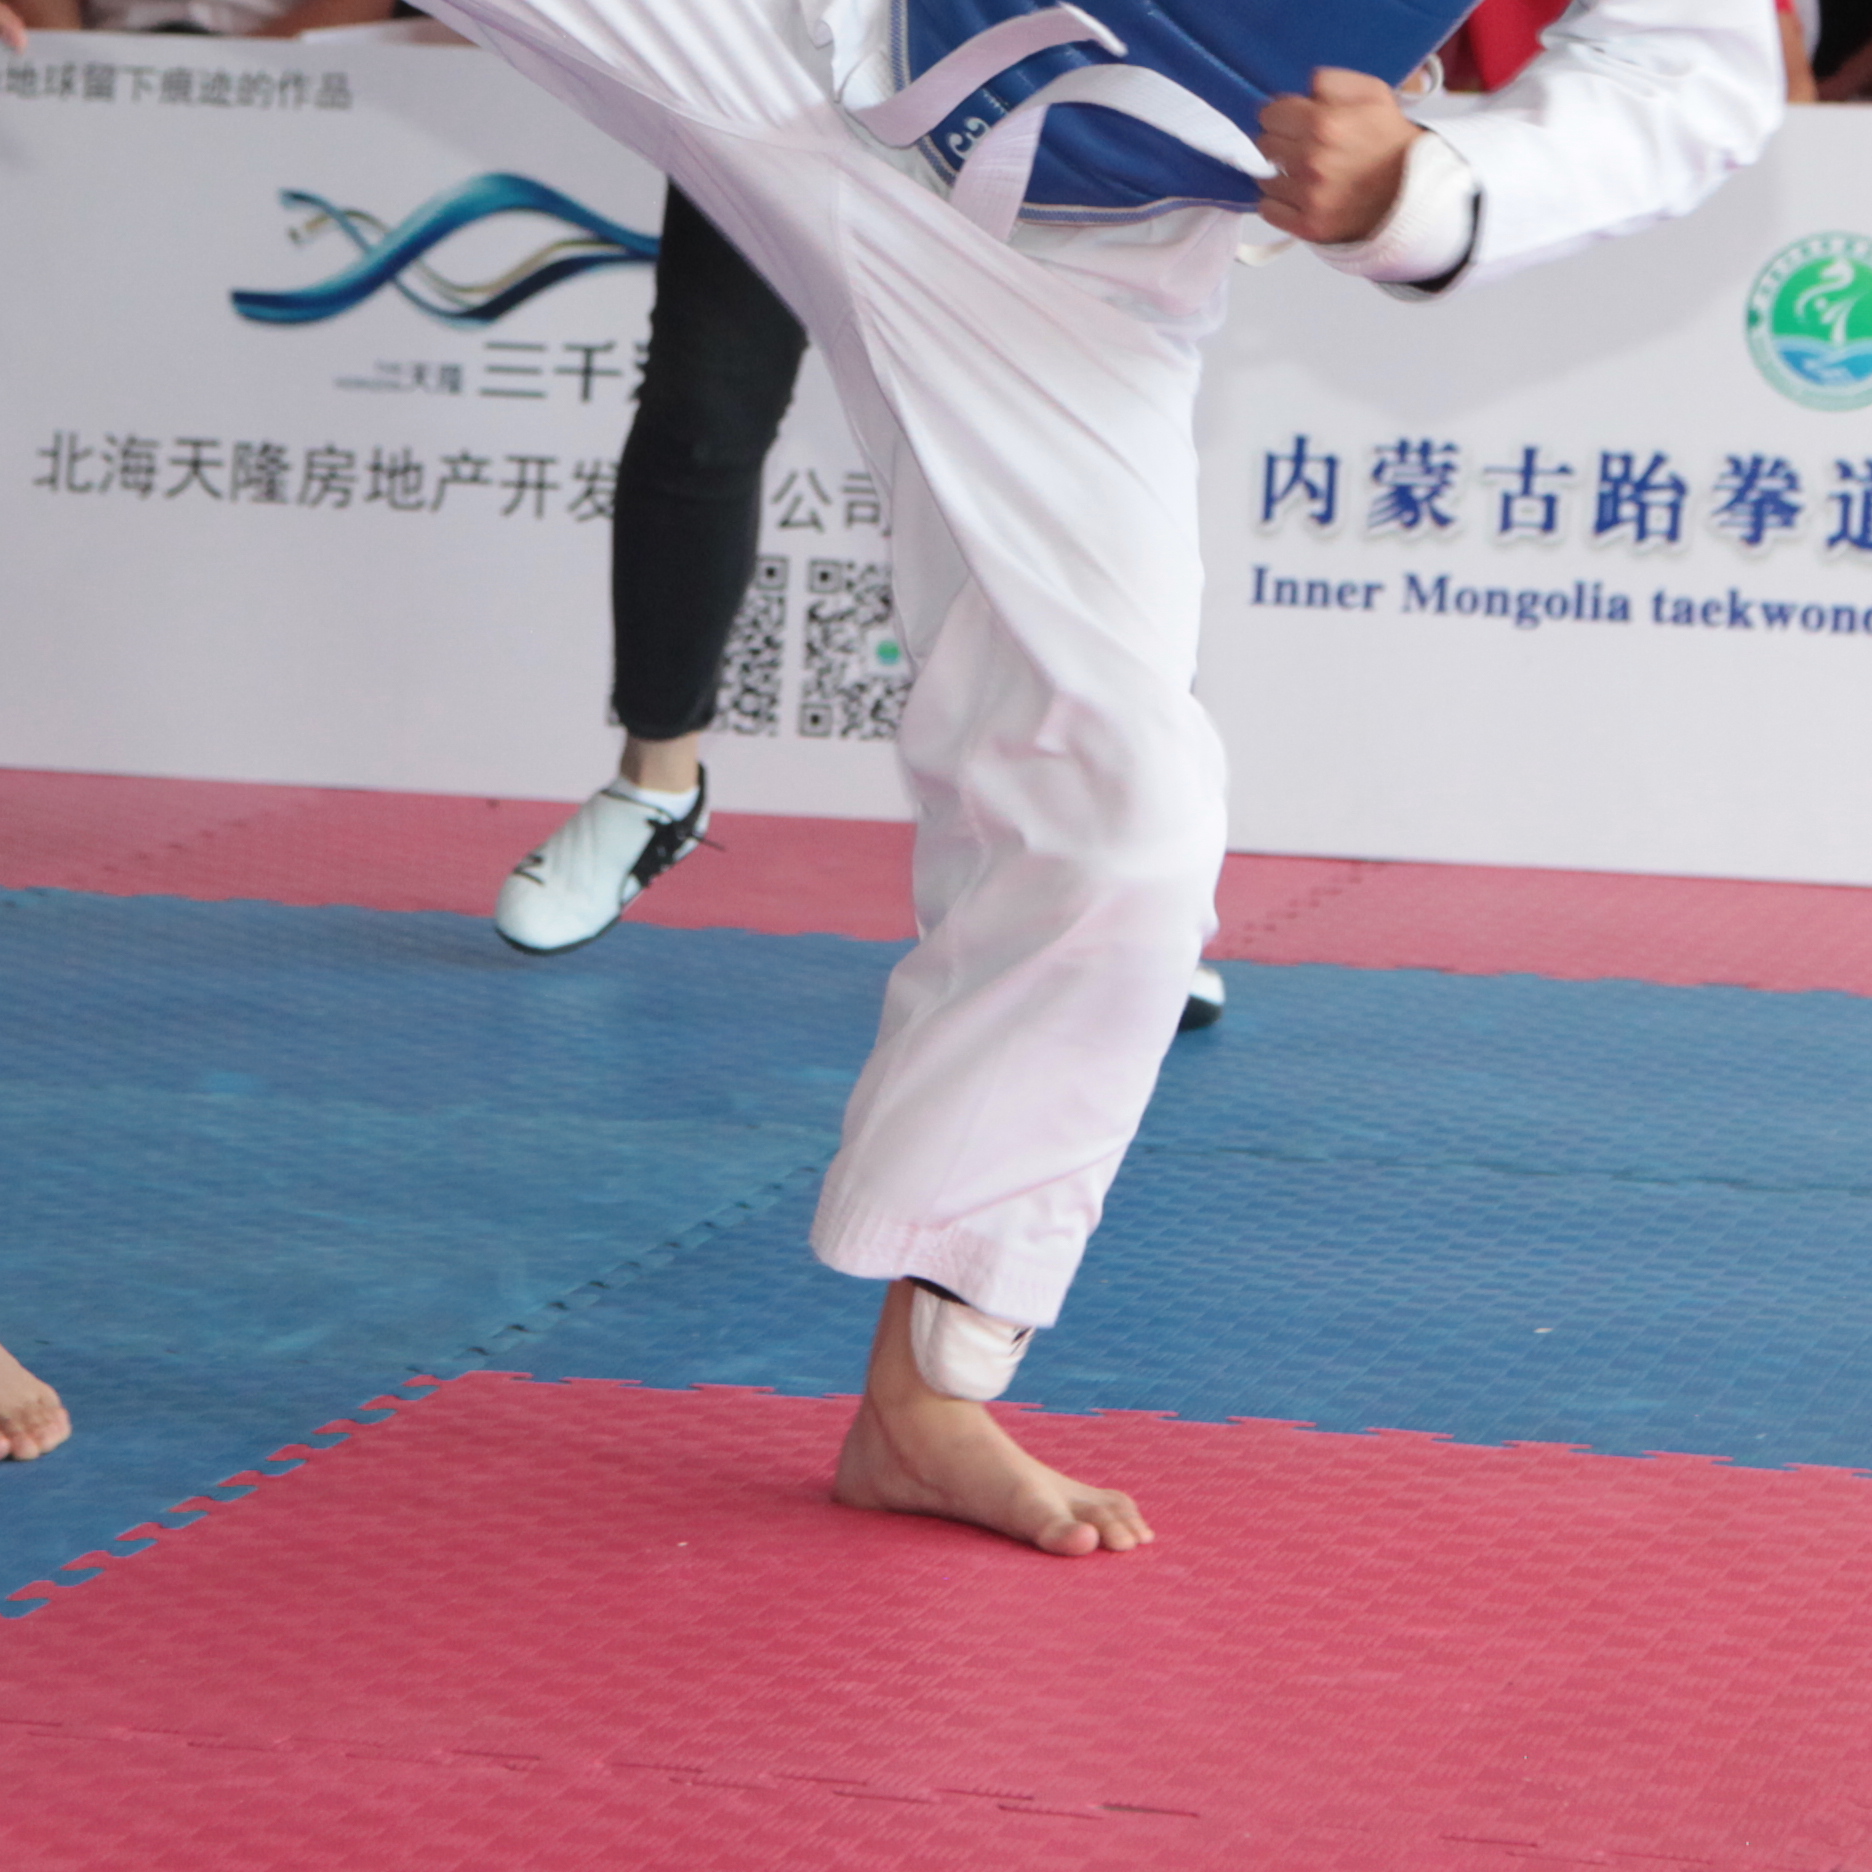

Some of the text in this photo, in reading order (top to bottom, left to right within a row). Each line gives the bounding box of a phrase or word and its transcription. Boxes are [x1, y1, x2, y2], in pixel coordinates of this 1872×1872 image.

[33, 429, 894, 540] 北海天隆房地产开发公司
[1250, 564, 1384, 610] Inner
[1401, 572, 1633, 628] Mongolia
